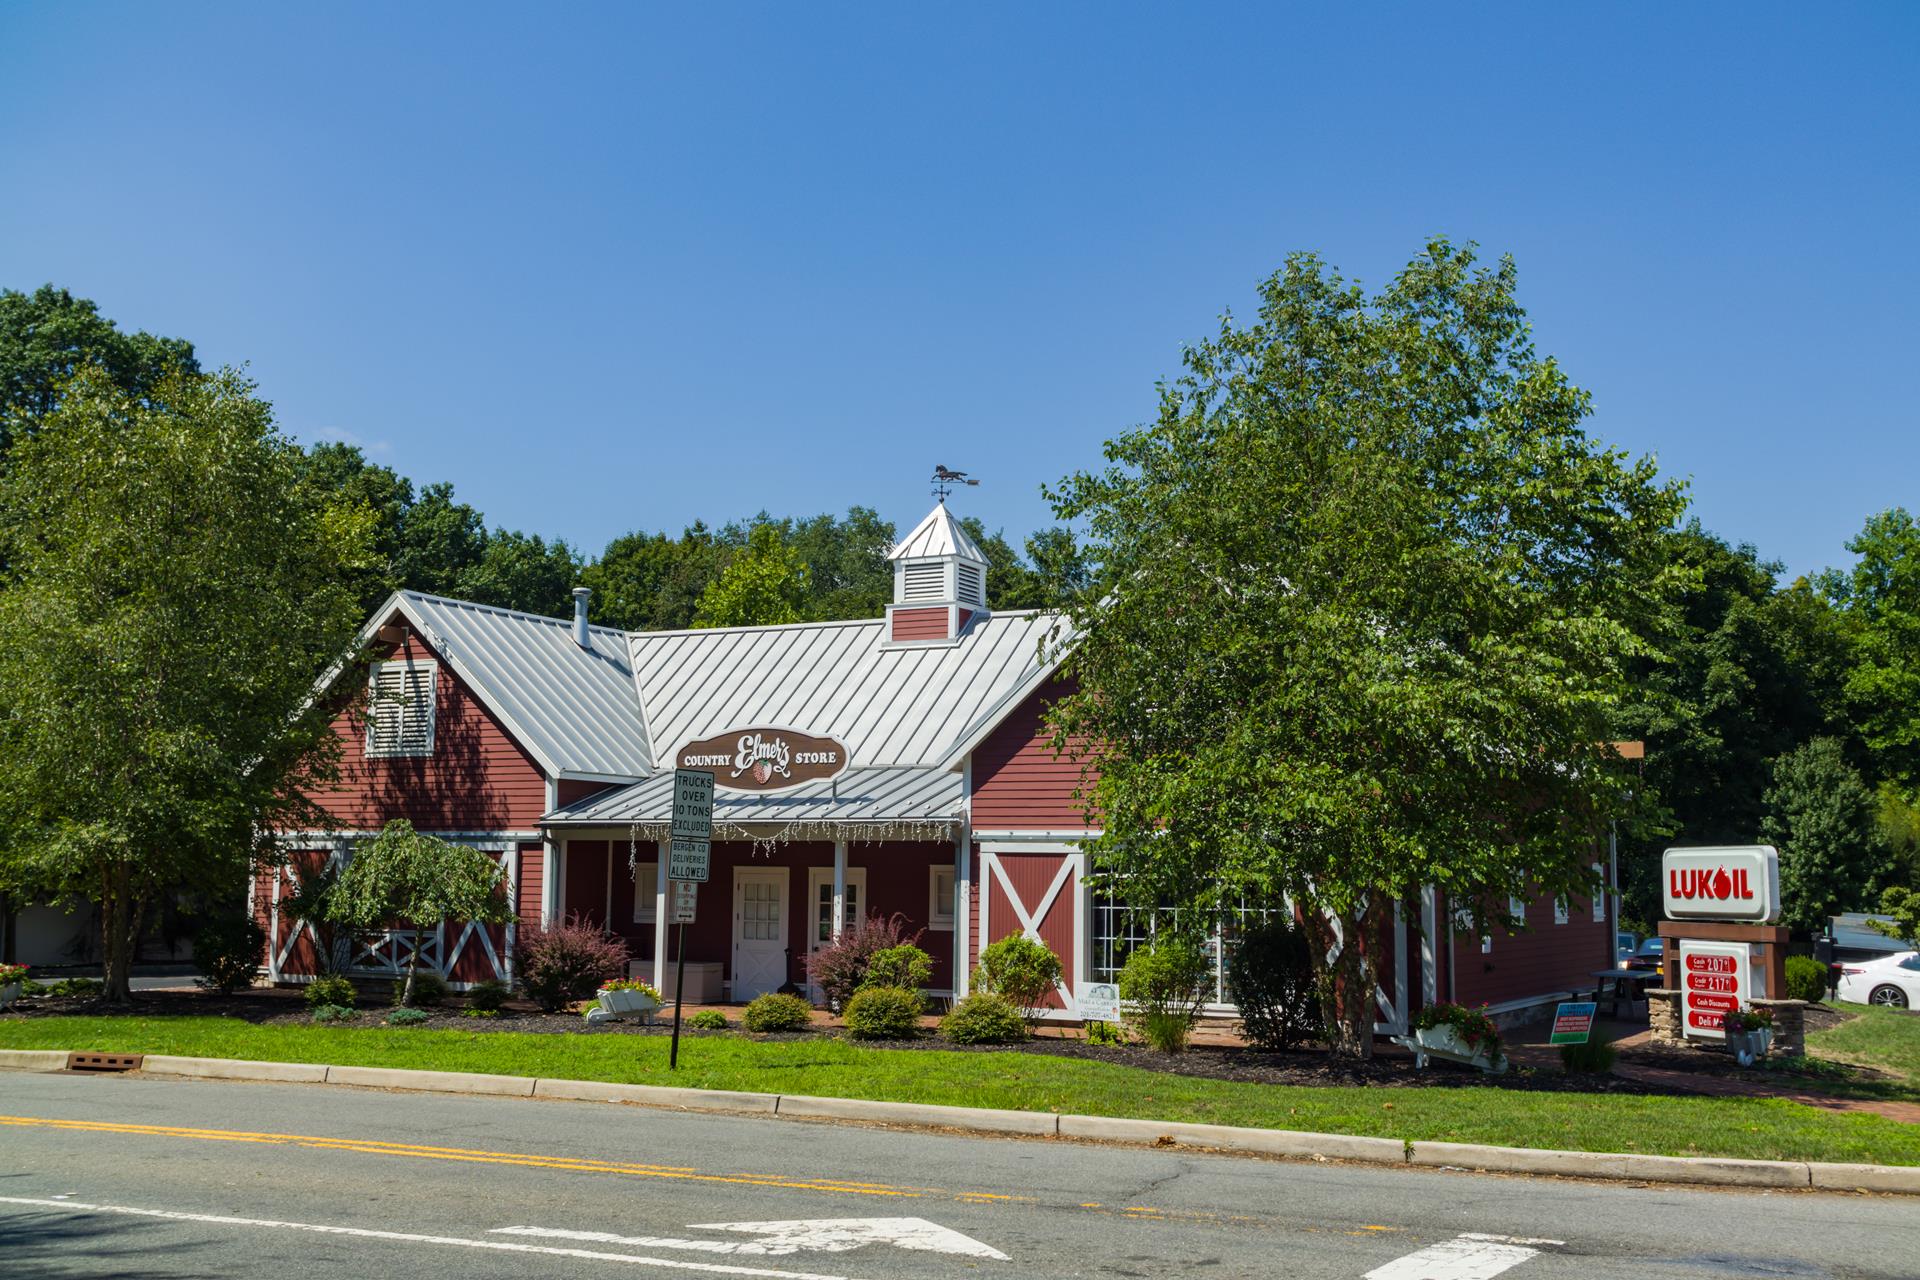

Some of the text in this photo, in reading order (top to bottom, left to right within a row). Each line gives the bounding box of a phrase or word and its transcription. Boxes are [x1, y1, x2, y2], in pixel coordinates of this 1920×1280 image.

[684, 733, 837, 778] COUNTRY Elmer's STORE
[677, 775, 712, 789] TRUCKS
[682, 790, 706, 802] OVER
[675, 804, 710, 817] 10 TONS
[673, 819, 710, 832] EXCLUDED
[673, 842, 706, 853] BERGEN CO
[672, 854, 706, 864] DELIVERIES
[671, 866, 706, 878] ALLOWED
[1670, 864, 1754, 900] LUKOIL
[1697, 998, 1731, 1009] Cash Discounts
[1699, 1015, 1711, 1026] Deli
